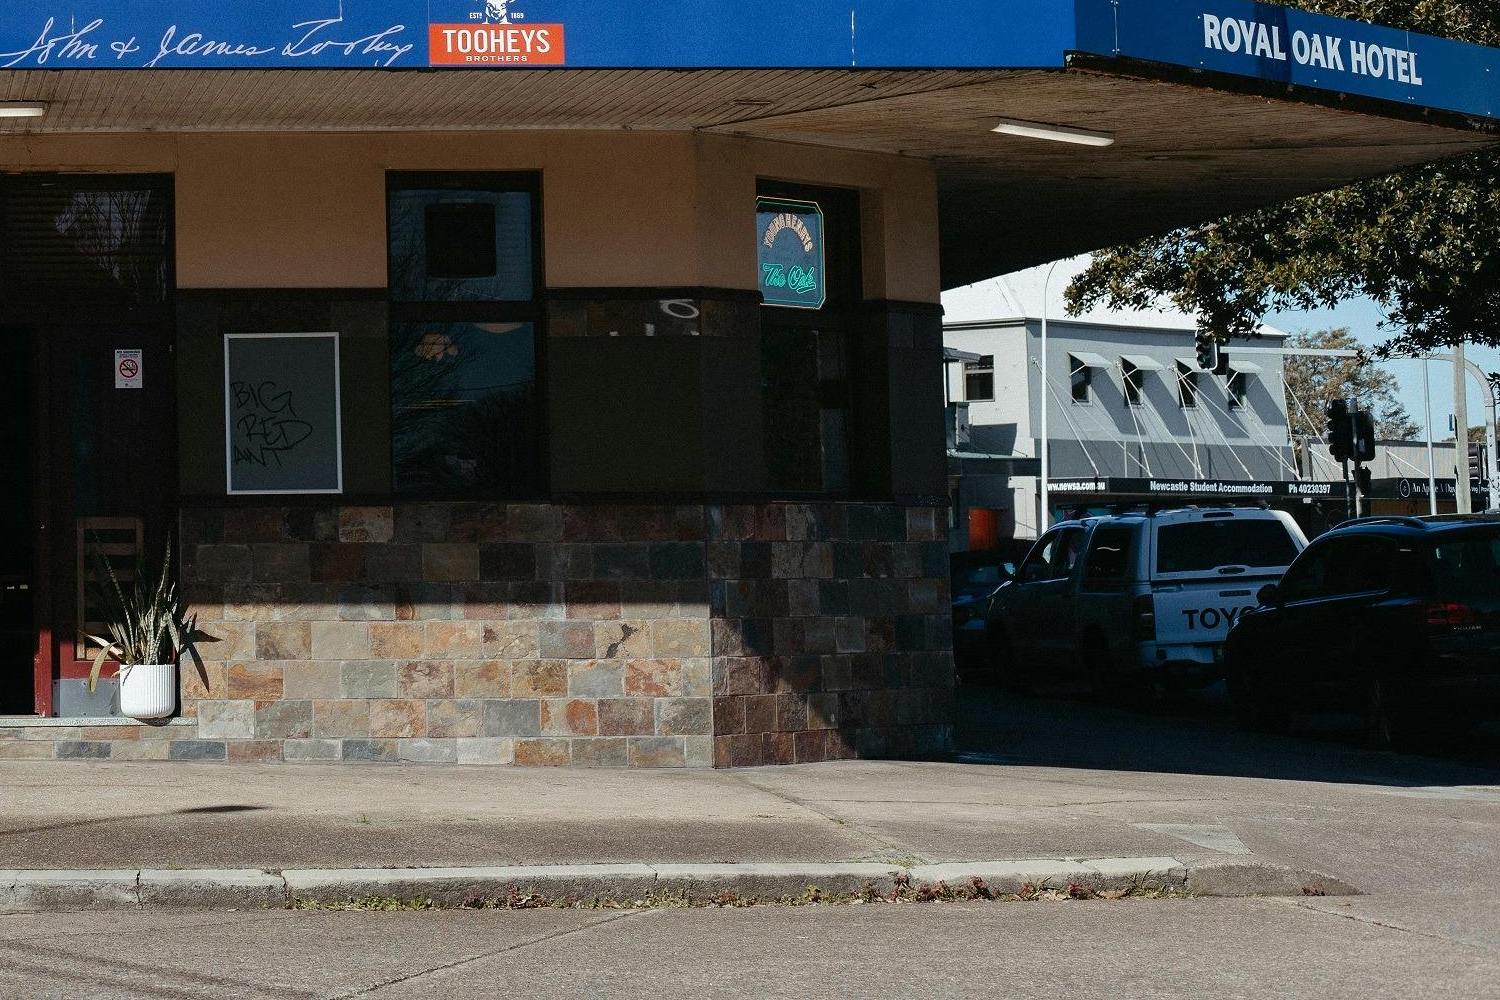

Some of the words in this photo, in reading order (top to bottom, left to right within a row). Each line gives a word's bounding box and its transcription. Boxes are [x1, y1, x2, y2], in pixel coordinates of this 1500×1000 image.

[110, 36, 141, 61] &
[144, 24, 276, 67] James
[282, 17, 414, 67] Toohey
[442, 29, 551, 53] TOOHEYS
[1203, 13, 1287, 61] ROYAL
[1291, 29, 1345, 72] OAK
[1350, 40, 1423, 86] HOTEL
[763, 262, 787, 288] The
[788, 264, 817, 295] Oak
[231, 380, 298, 418] BIG
[236, 412, 314, 450] RED
[1046, 481, 1106, 491] ww.newsa.comau
[1149, 480, 1189, 492] Newcastle
[1190, 481, 1218, 492] Student
[1218, 482, 1273, 493] Accommodation
[1288, 483, 1298, 494] Ph
[1412, 482, 1421, 493] An
[1421, 482, 1438, 496] Ape
